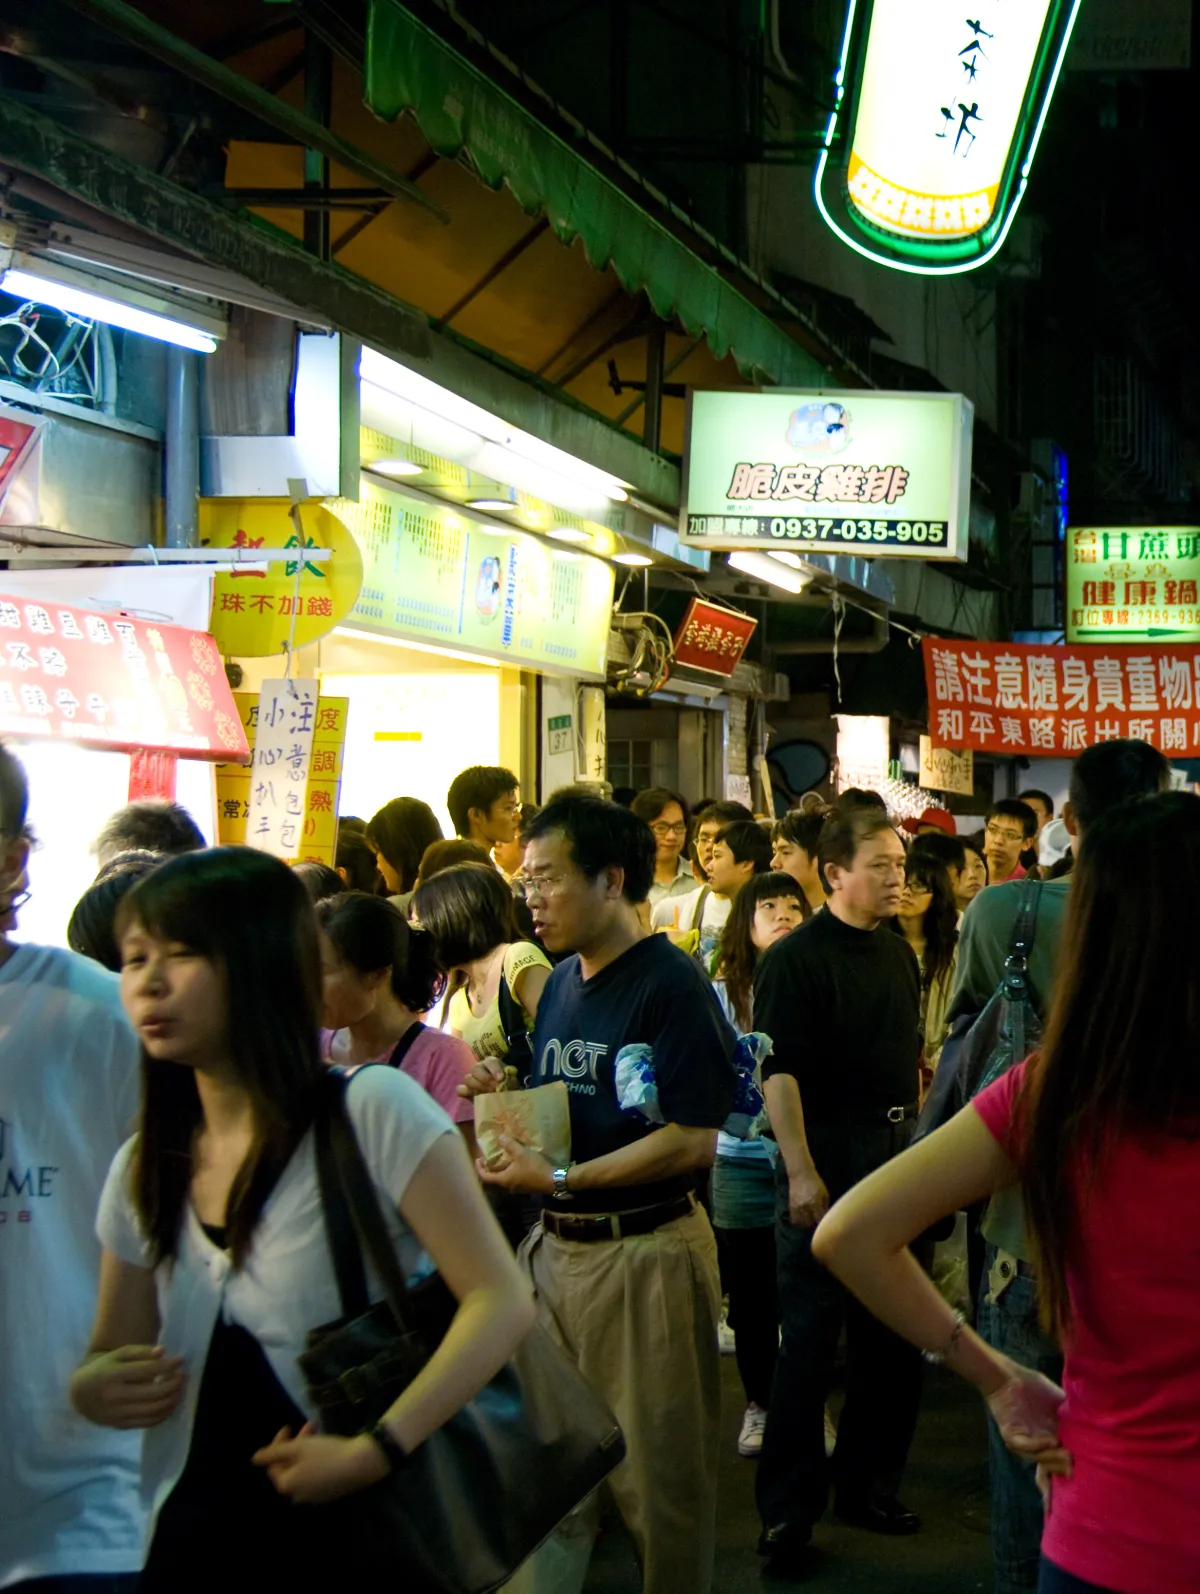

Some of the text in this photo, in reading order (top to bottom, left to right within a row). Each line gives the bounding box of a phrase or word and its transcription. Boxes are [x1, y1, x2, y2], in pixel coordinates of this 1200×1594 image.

[726, 463, 909, 503] 脆皮雞排
[770, 518, 944, 543] 0937-035-905
[1082, 580, 1198, 606] 健康鍋
